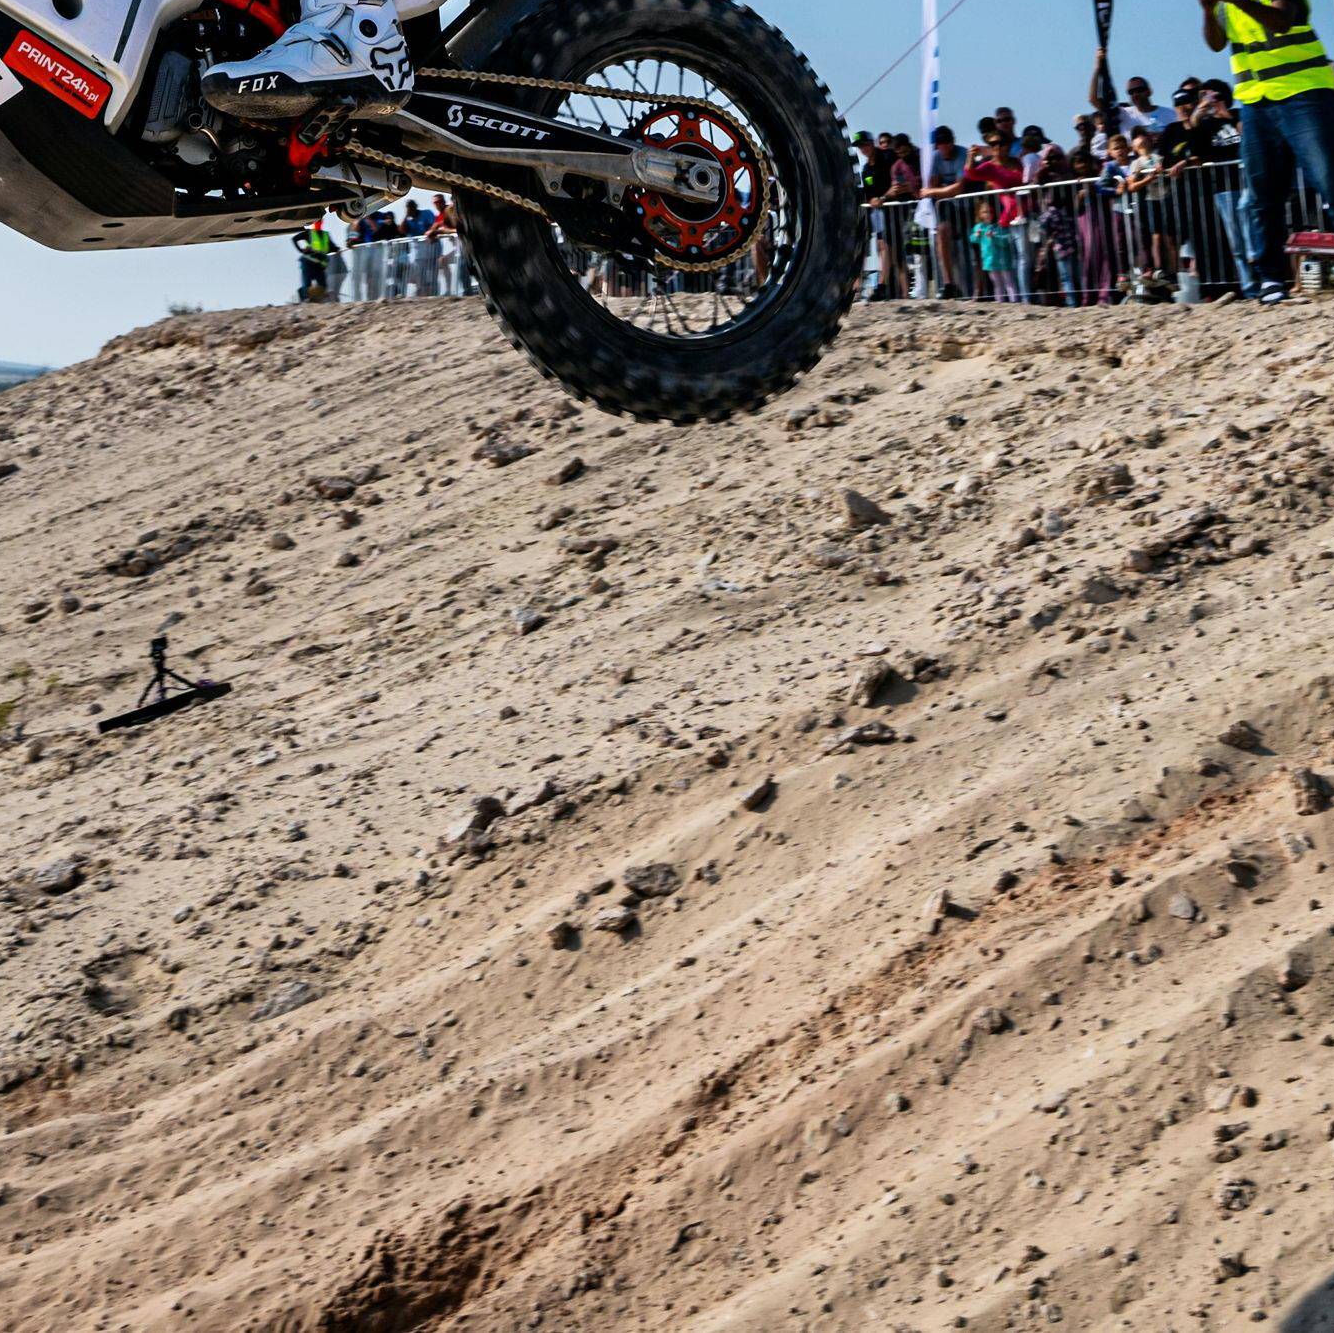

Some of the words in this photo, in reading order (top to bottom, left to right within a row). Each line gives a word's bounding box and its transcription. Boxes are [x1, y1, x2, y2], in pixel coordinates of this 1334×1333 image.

[17, 41, 100, 103] PRINT24h.pl
[238, 75, 279, 94] FOX
[465, 114, 552, 141] SCOTT
